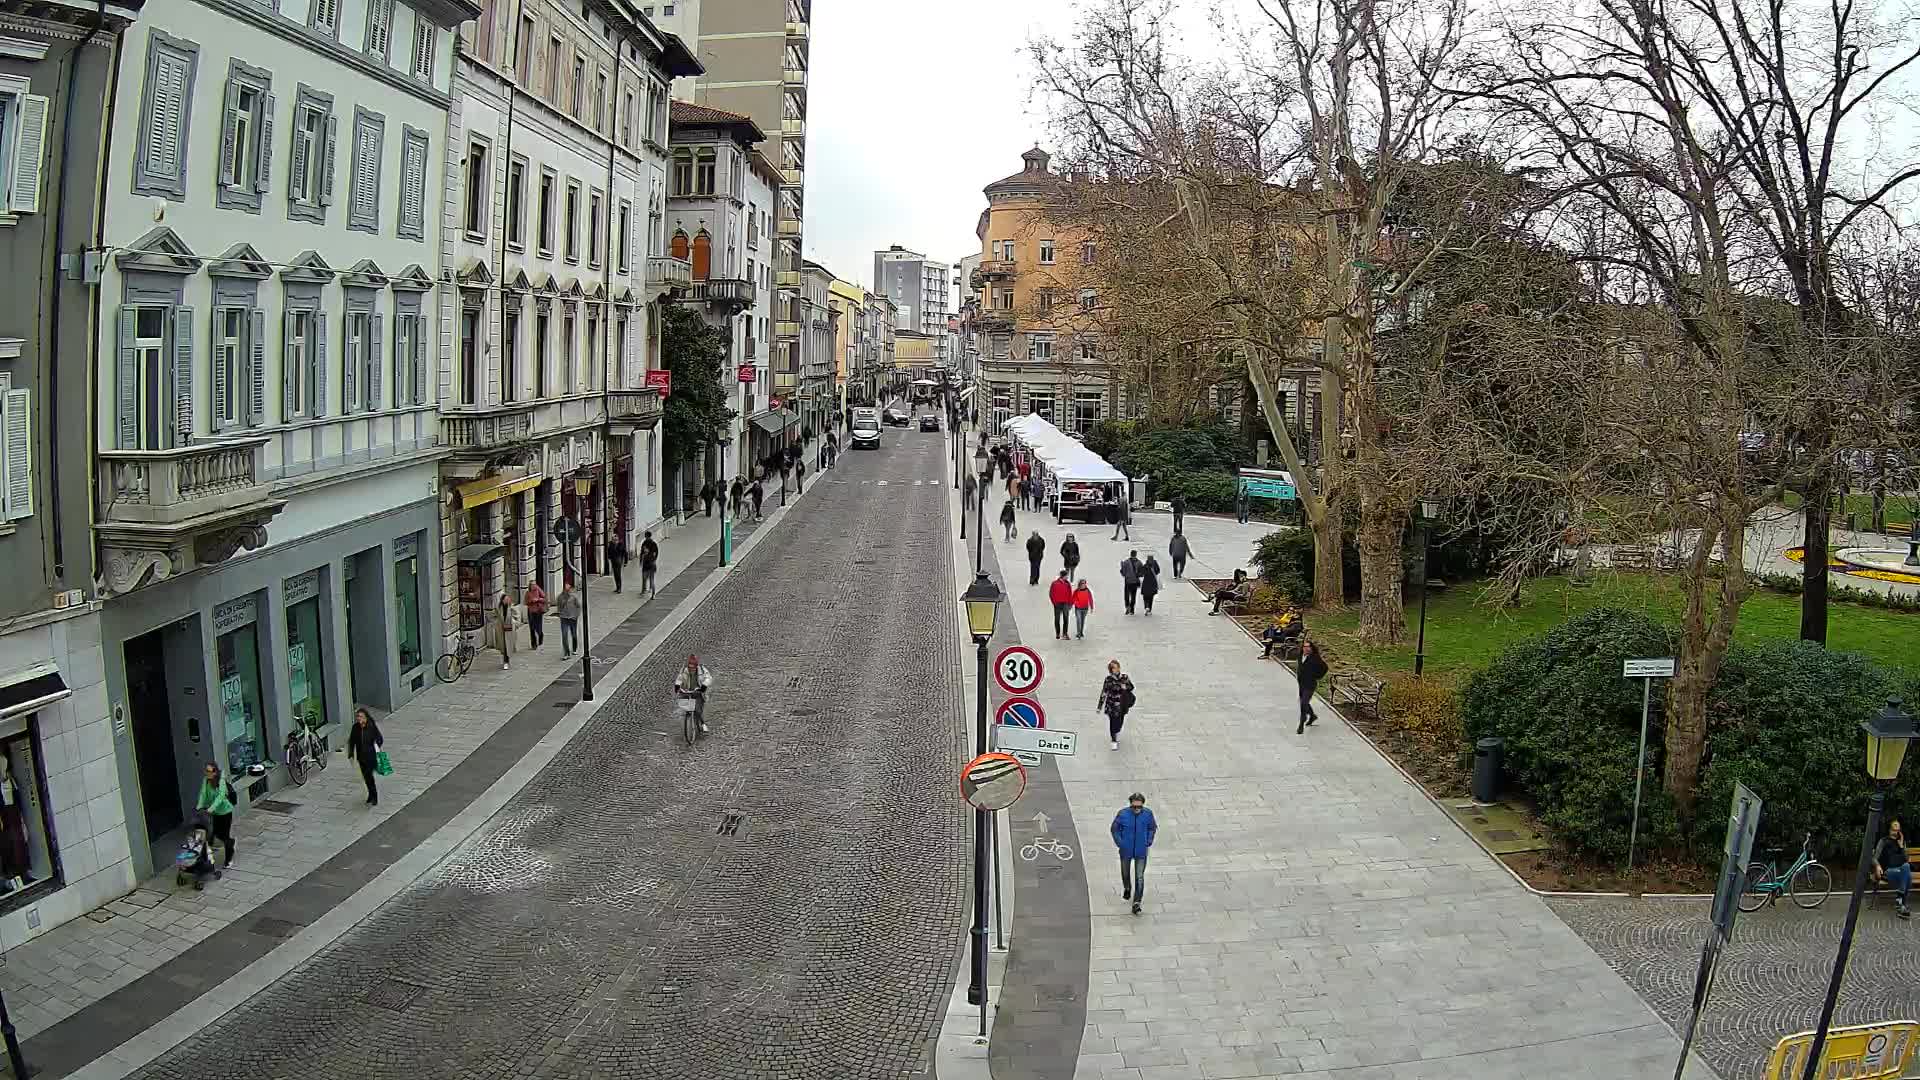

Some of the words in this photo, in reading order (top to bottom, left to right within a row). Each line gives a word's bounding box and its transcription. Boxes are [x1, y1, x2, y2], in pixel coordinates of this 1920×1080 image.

[1005, 659, 1034, 681] 30
[224, 679, 240, 701] 130
[1038, 739, 1070, 750] Dante
